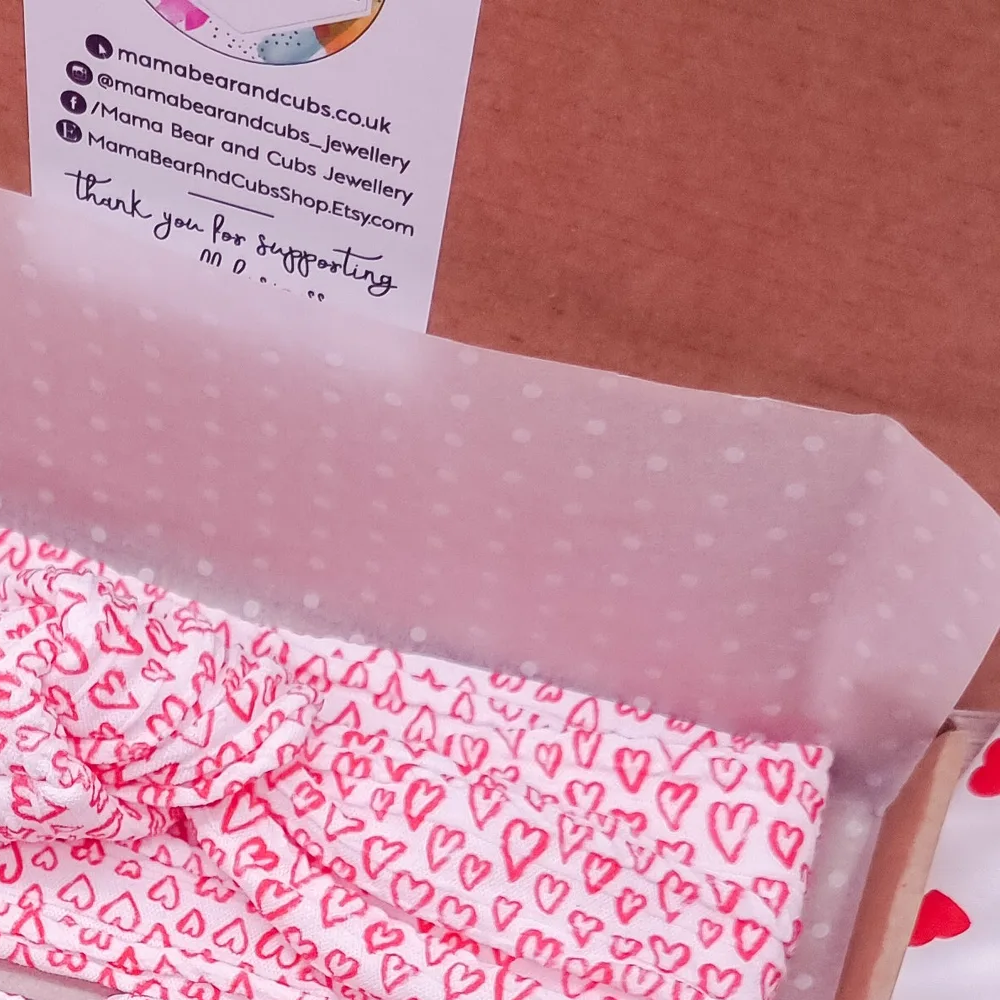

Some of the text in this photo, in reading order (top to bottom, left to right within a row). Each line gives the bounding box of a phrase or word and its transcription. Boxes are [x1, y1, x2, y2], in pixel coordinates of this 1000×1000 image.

[118, 47, 392, 135] mamabearandcubs.co.uk
[88, 131, 415, 237] MamaBearAndCubsShop.Etsy.com
[171, 122, 215, 148] Bear
[220, 140, 260, 161] and
[266, 150, 317, 177] Cubs
[322, 166, 414, 207] Jewellery
[64, 169, 153, 219] thank
[153, 211, 205, 241] you
[212, 213, 247, 247] for
[256, 233, 398, 298] supporting
